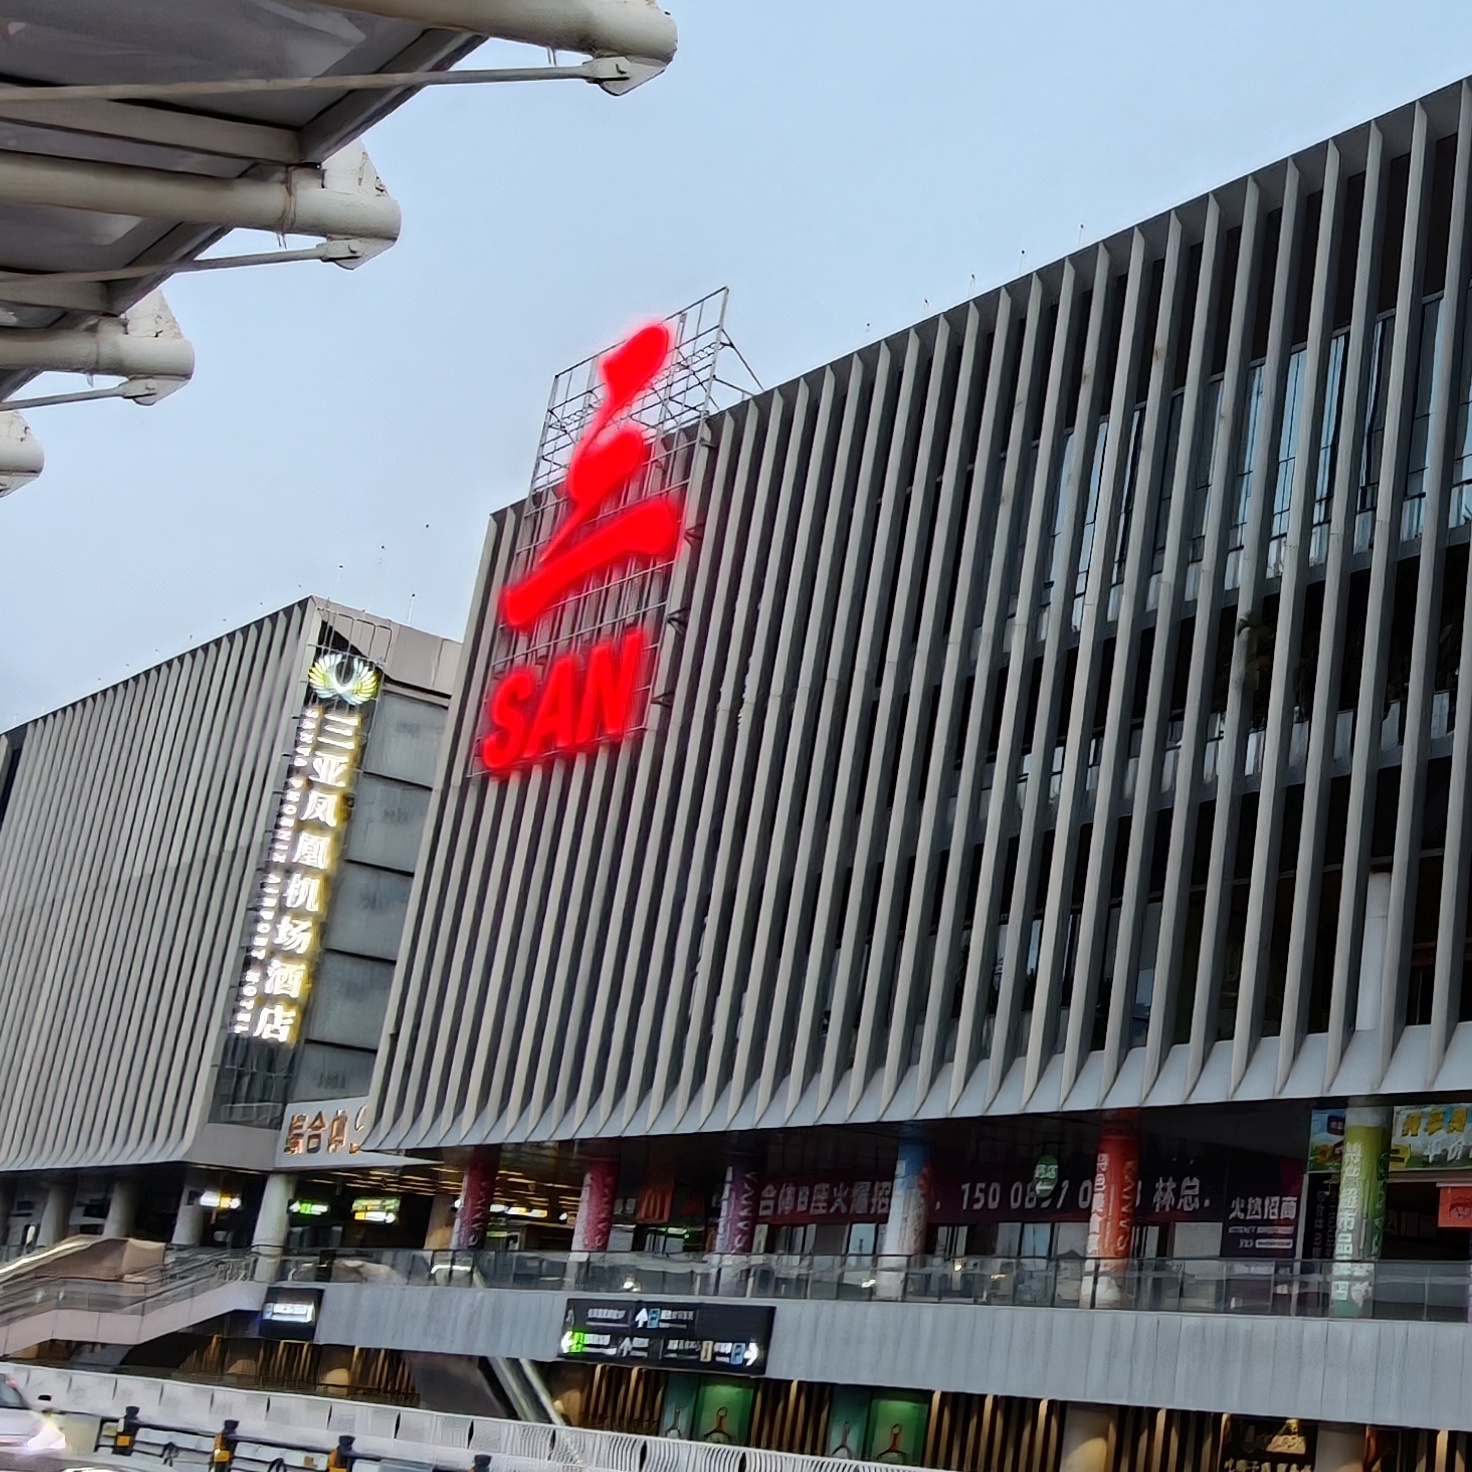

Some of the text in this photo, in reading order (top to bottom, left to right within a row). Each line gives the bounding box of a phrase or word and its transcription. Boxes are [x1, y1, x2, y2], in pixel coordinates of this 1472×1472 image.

[481, 628, 644, 770] SAN
[253, 712, 359, 1043] 三亚凤凰机场酒店
